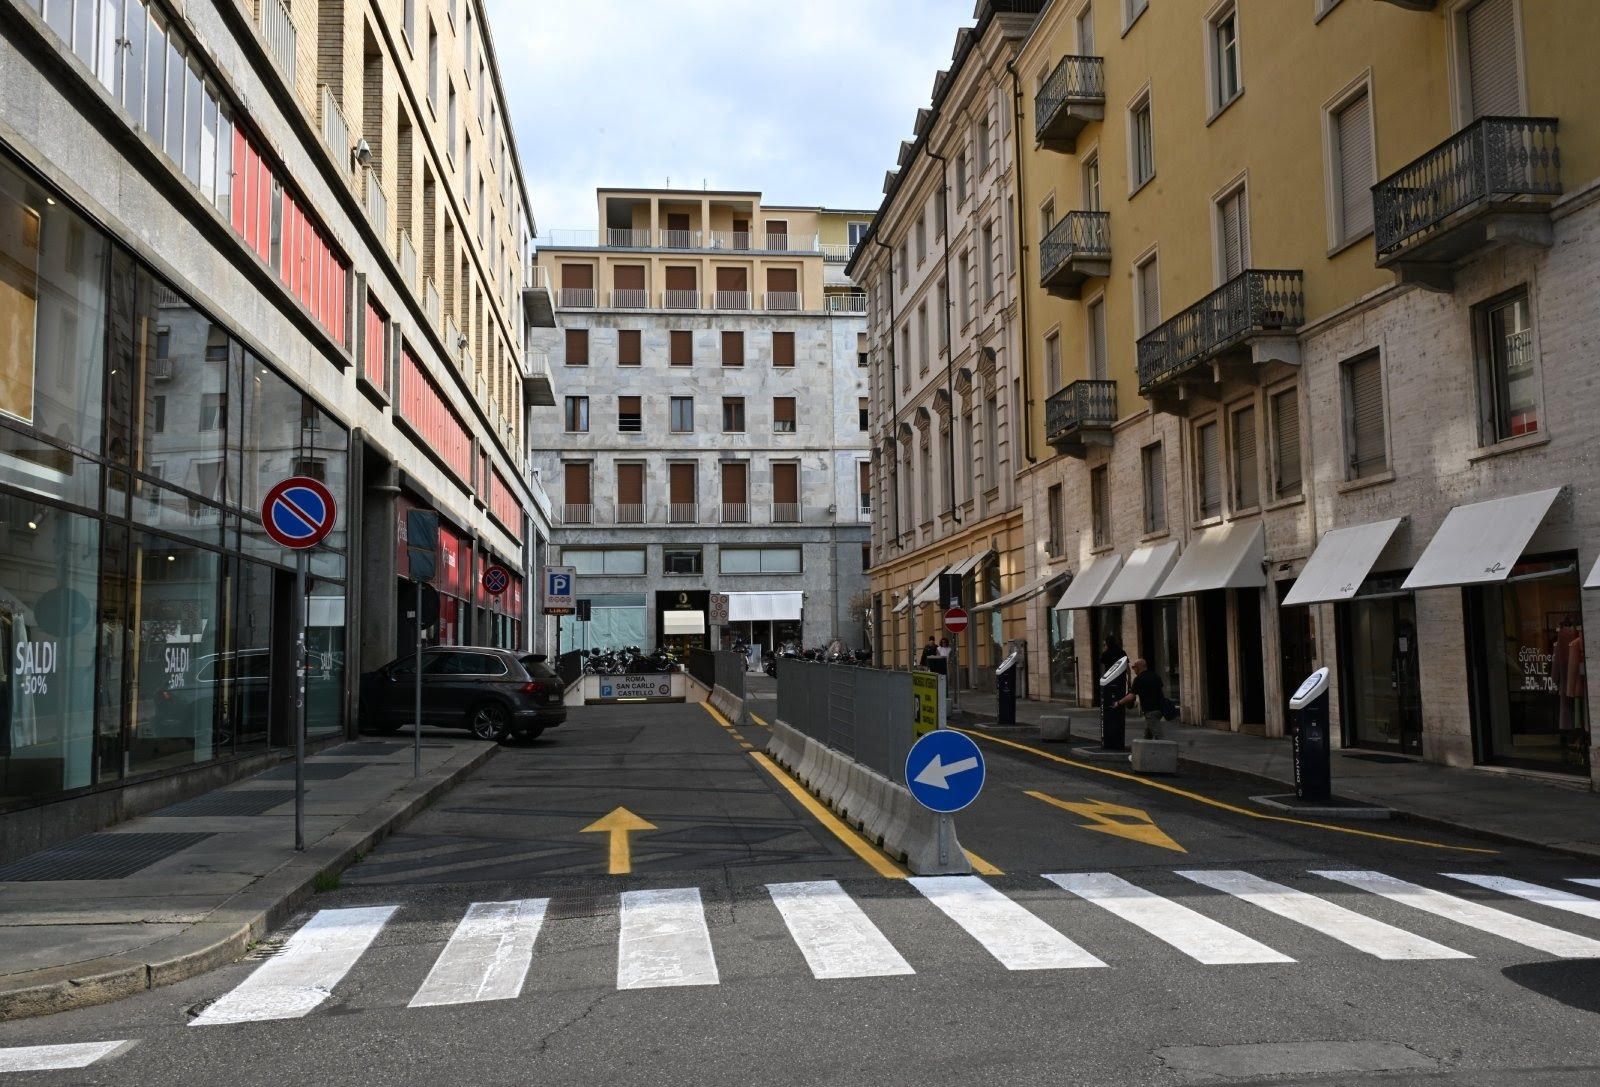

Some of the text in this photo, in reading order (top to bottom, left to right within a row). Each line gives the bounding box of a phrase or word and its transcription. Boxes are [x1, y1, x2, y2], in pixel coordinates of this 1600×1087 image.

[15, 641, 57, 675] SALDI
[1518, 652, 1555, 662] Summer
[1521, 645, 1541, 655] Crazy
[164, 647, 189, 673] SALDI
[1524, 662, 1548, 675] SALE
[21, 675, 48, 695] -50%
